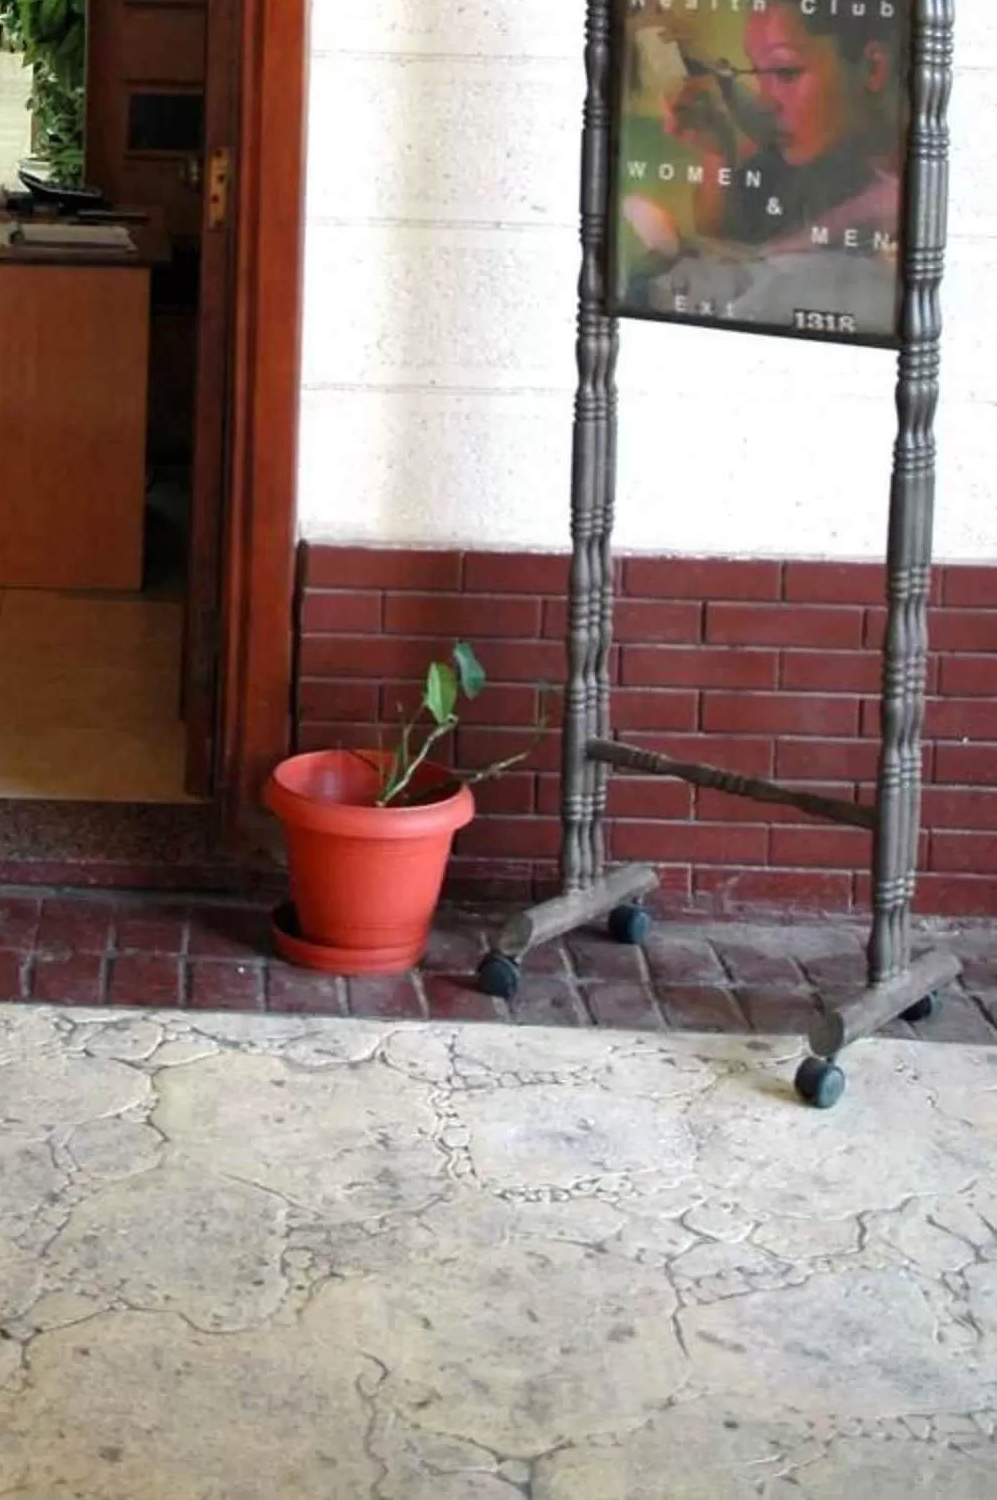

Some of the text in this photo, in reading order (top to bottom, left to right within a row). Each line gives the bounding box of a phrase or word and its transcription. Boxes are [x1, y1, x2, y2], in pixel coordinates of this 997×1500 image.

[627, 160, 761, 188] WOMEN
[766, 196, 783, 216] &
[810, 225, 893, 251] MEN
